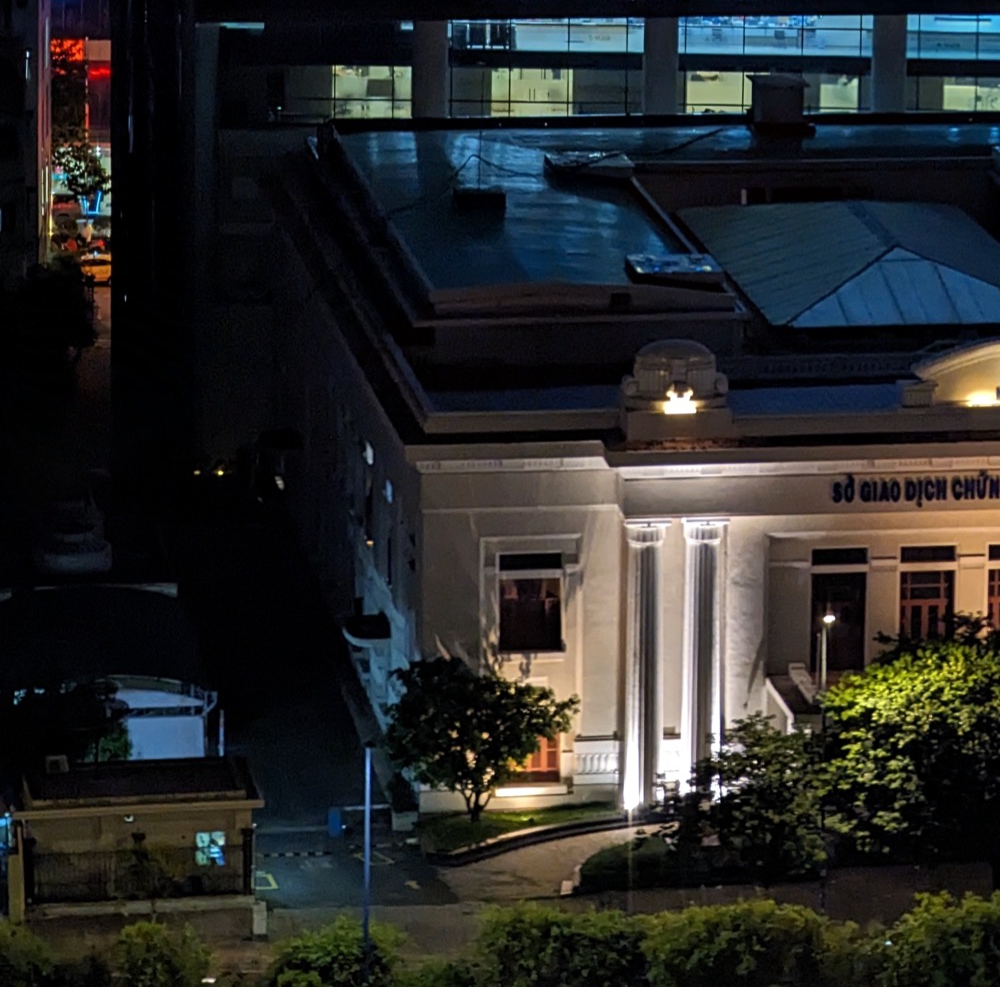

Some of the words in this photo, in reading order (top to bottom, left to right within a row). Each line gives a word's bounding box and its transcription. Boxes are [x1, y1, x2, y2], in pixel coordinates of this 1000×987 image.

[832, 473, 855, 503] SỞ
[860, 477, 901, 503] GIAO
[904, 476, 948, 508] DỊCH
